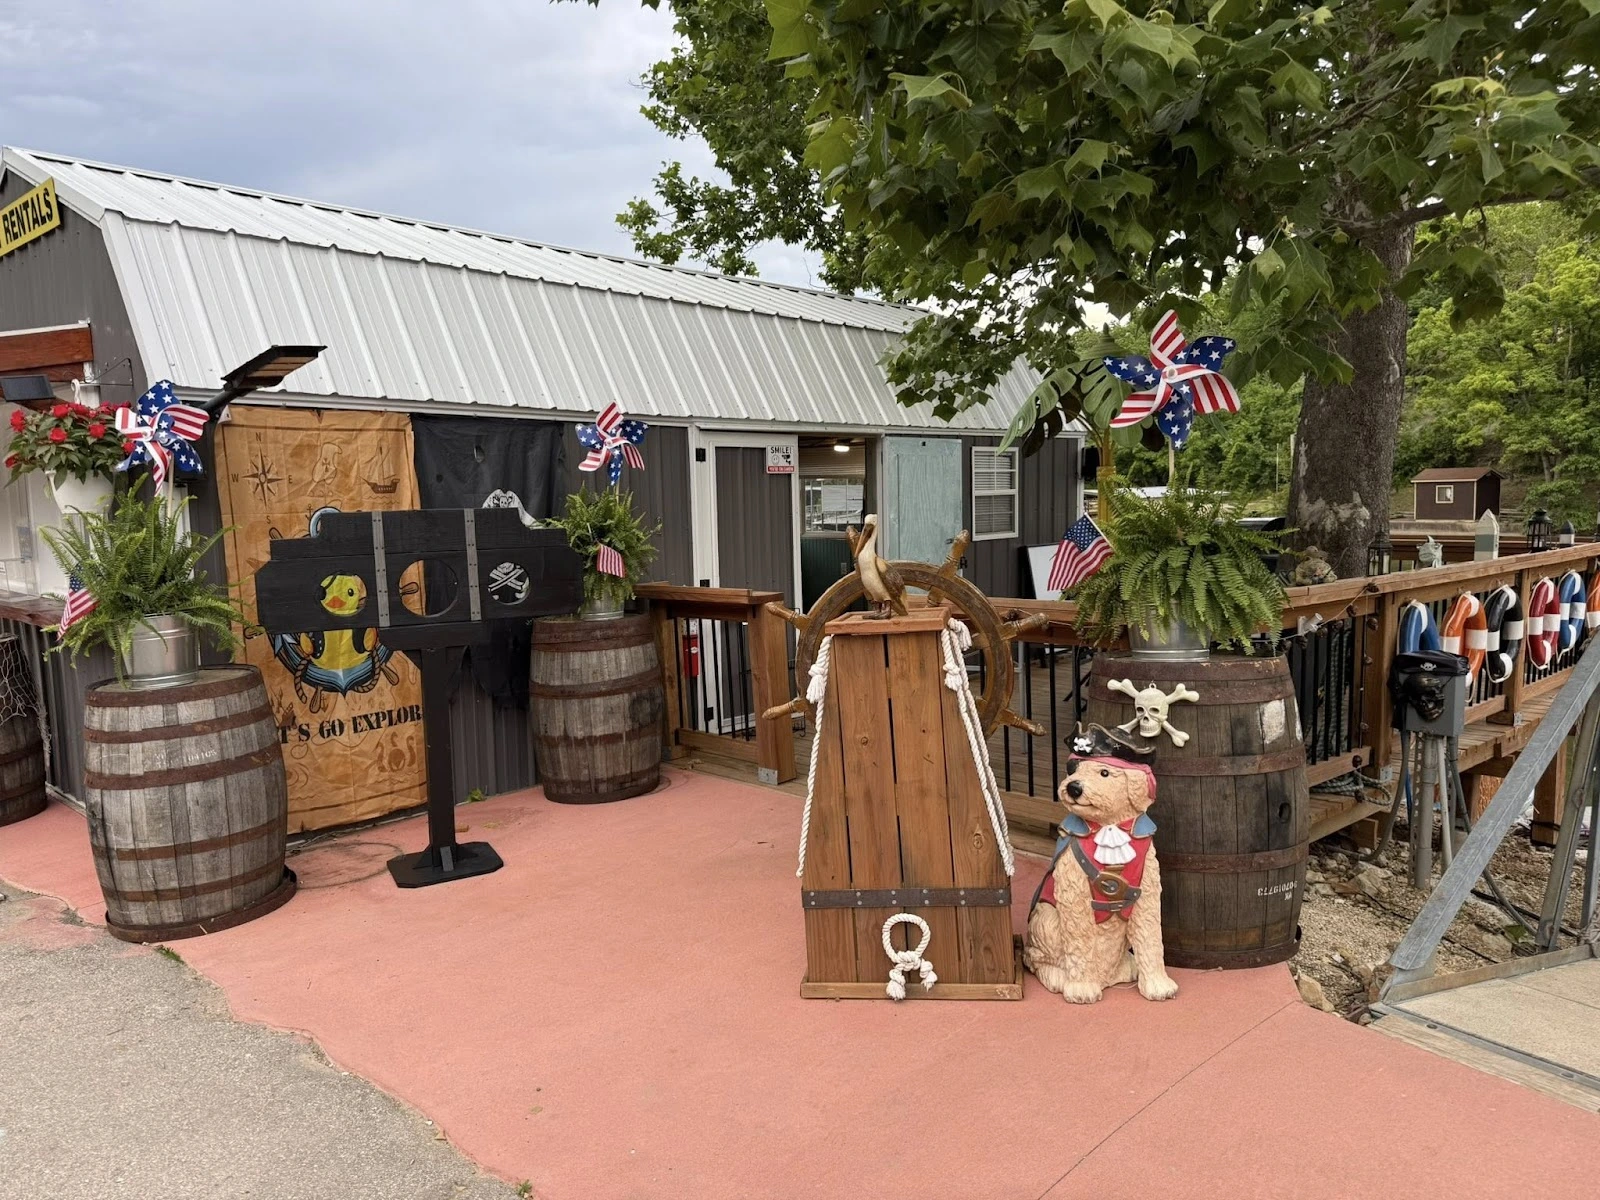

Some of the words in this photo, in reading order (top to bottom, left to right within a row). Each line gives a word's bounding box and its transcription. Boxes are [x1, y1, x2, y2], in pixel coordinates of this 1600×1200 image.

[2, 187, 53, 245] RENTALS
[255, 431, 262, 442] N
[770, 446, 792, 454] SMILE!
[231, 473, 239, 483] W
[288, 474, 293, 484] E
[266, 515, 271, 524] S
[278, 716, 311, 743] T'S
[318, 718, 345, 739] GO
[352, 704, 422, 734] EXPLOR
